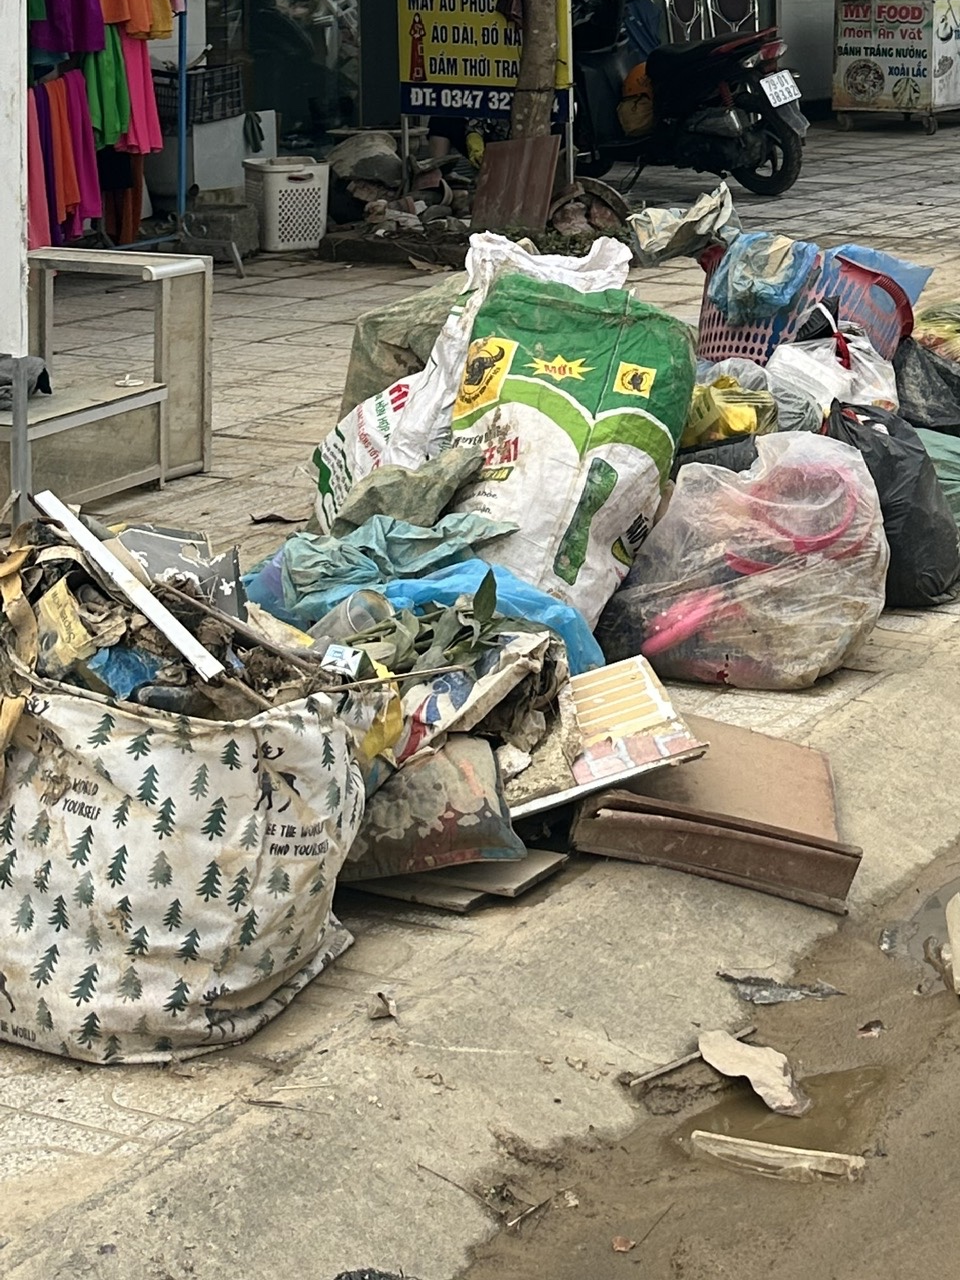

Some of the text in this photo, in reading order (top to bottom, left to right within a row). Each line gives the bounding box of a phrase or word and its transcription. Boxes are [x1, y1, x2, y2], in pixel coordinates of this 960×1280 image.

[843, 4, 923, 23] MY FOOD
[431, 24, 448, 44] ÁO
[452, 24, 478, 47] DÀI,
[843, 24, 923, 42] Món Ăn Vặt
[838, 42, 862, 56] BÁNH
[864, 43, 893, 58] TRÁNG
[462, 54, 490, 77] THỜI
[494, 59, 519, 78] TRA
[911, 62, 927, 78] LẮC
[410, 88, 437, 107] ĐT:
[441, 90, 483, 109] 0347
[544, 363, 573, 376] MỚI
[72, 777, 99, 796] WORLD
[62, 798, 101, 820] YOURSELF
[281, 824, 297, 838] THE
[270, 842, 290, 856] FIND
[11, 1023, 37, 1042] WORLD
